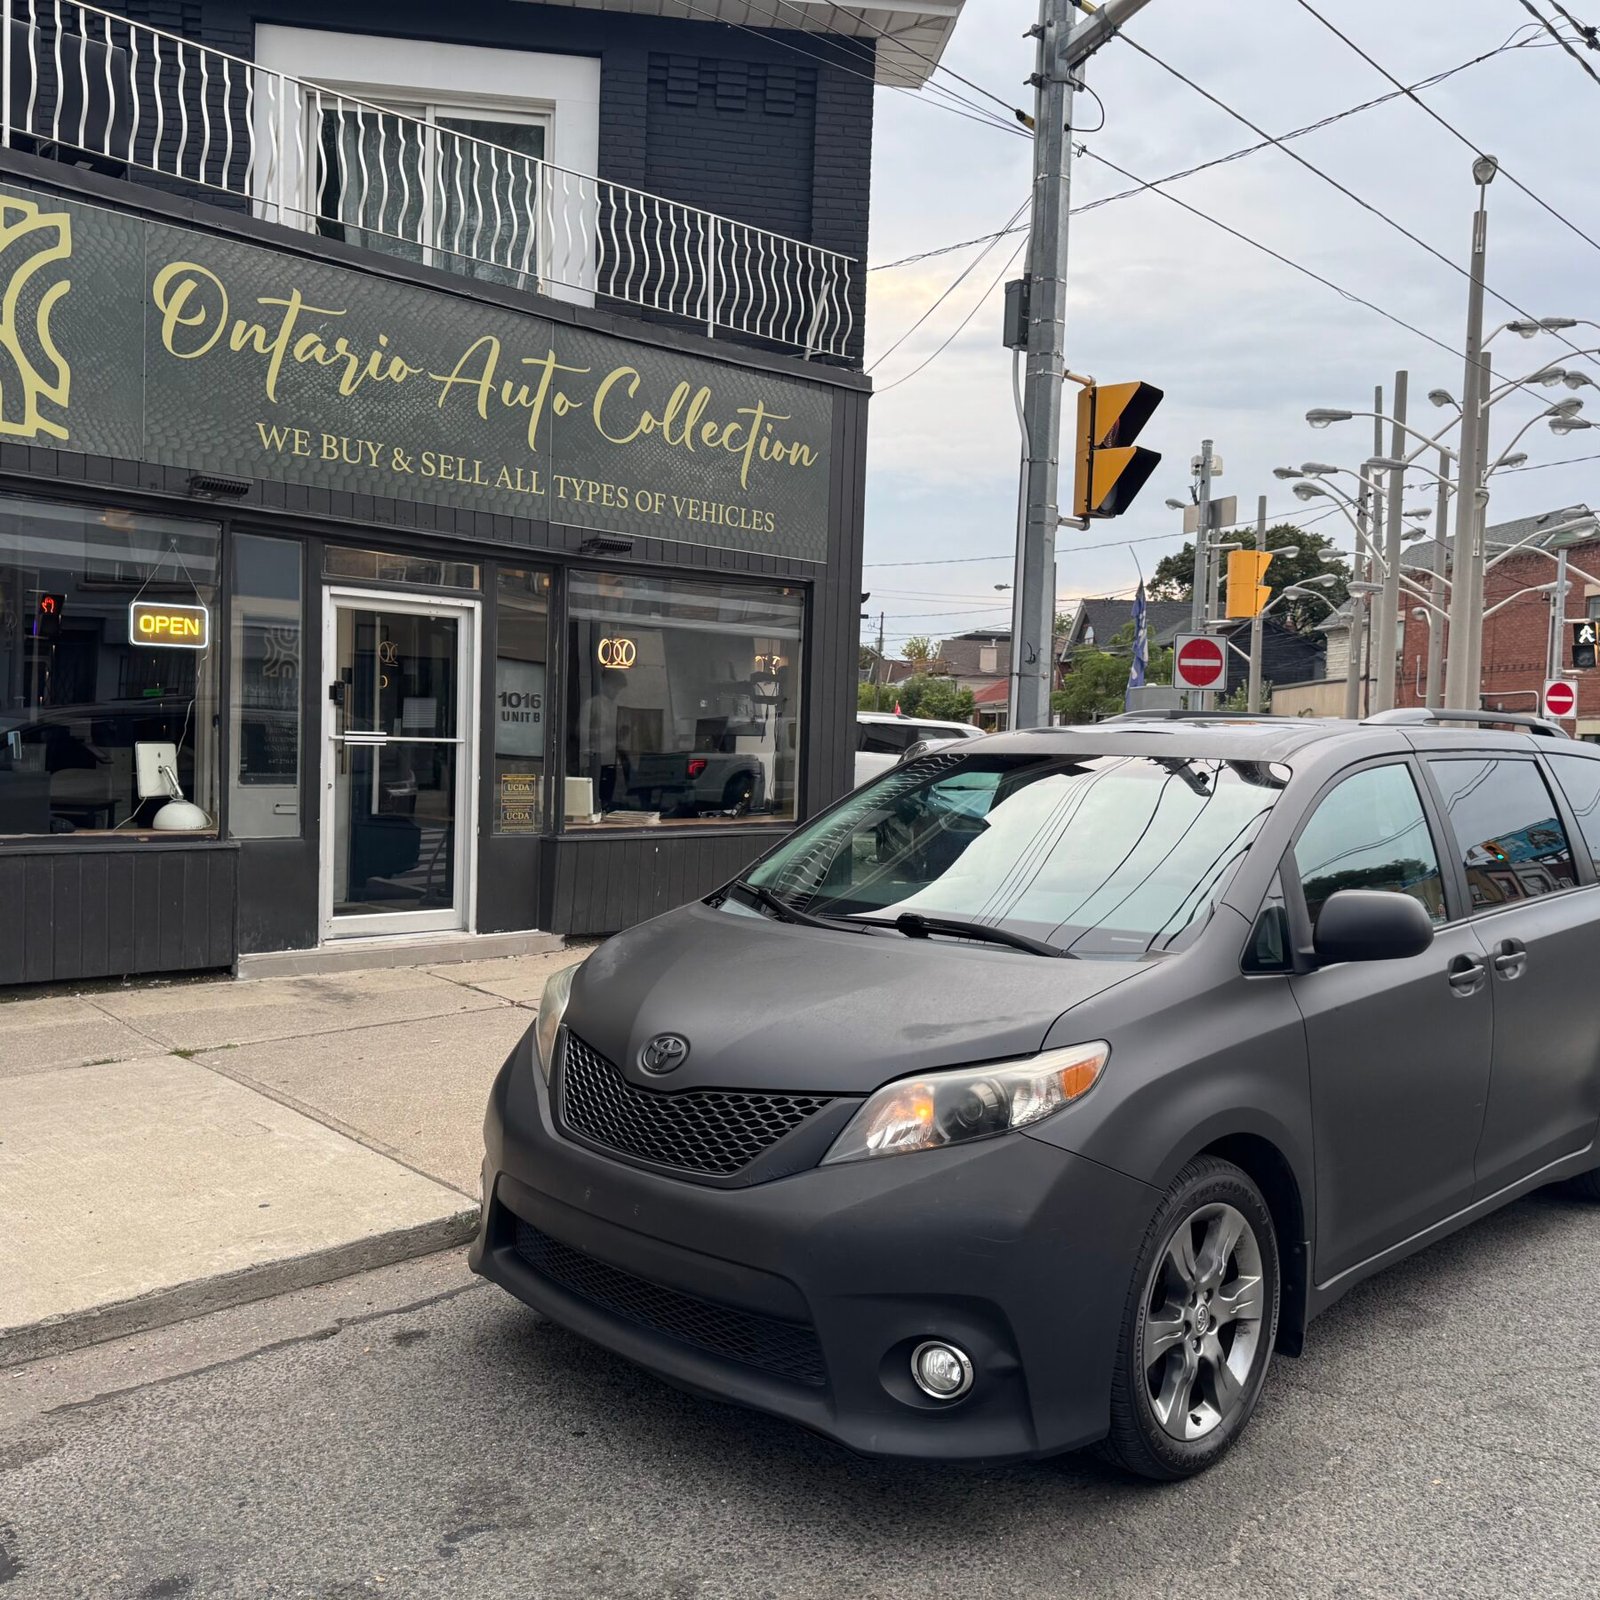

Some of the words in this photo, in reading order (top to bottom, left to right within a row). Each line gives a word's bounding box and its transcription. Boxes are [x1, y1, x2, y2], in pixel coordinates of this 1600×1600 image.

[152, 261, 424, 404] Ontario
[428, 335, 591, 451] Auto
[592, 366, 818, 489] Collection
[256, 422, 312, 456] WE
[320, 433, 385, 467] BUY
[391, 447, 414, 474] &
[420, 451, 489, 486] SELL
[494, 464, 545, 495] ALL
[552, 474, 629, 509] TYPES
[635, 490, 666, 515] OF
[671, 495, 776, 533] VEHICLES
[139, 614, 199, 636] OPEN
[498, 691, 542, 709] 1016
[501, 711, 532, 723] UNIT
[533, 712, 541, 723] B
[507, 783, 530, 791] UCDA
[506, 812, 530, 820] UCDA
